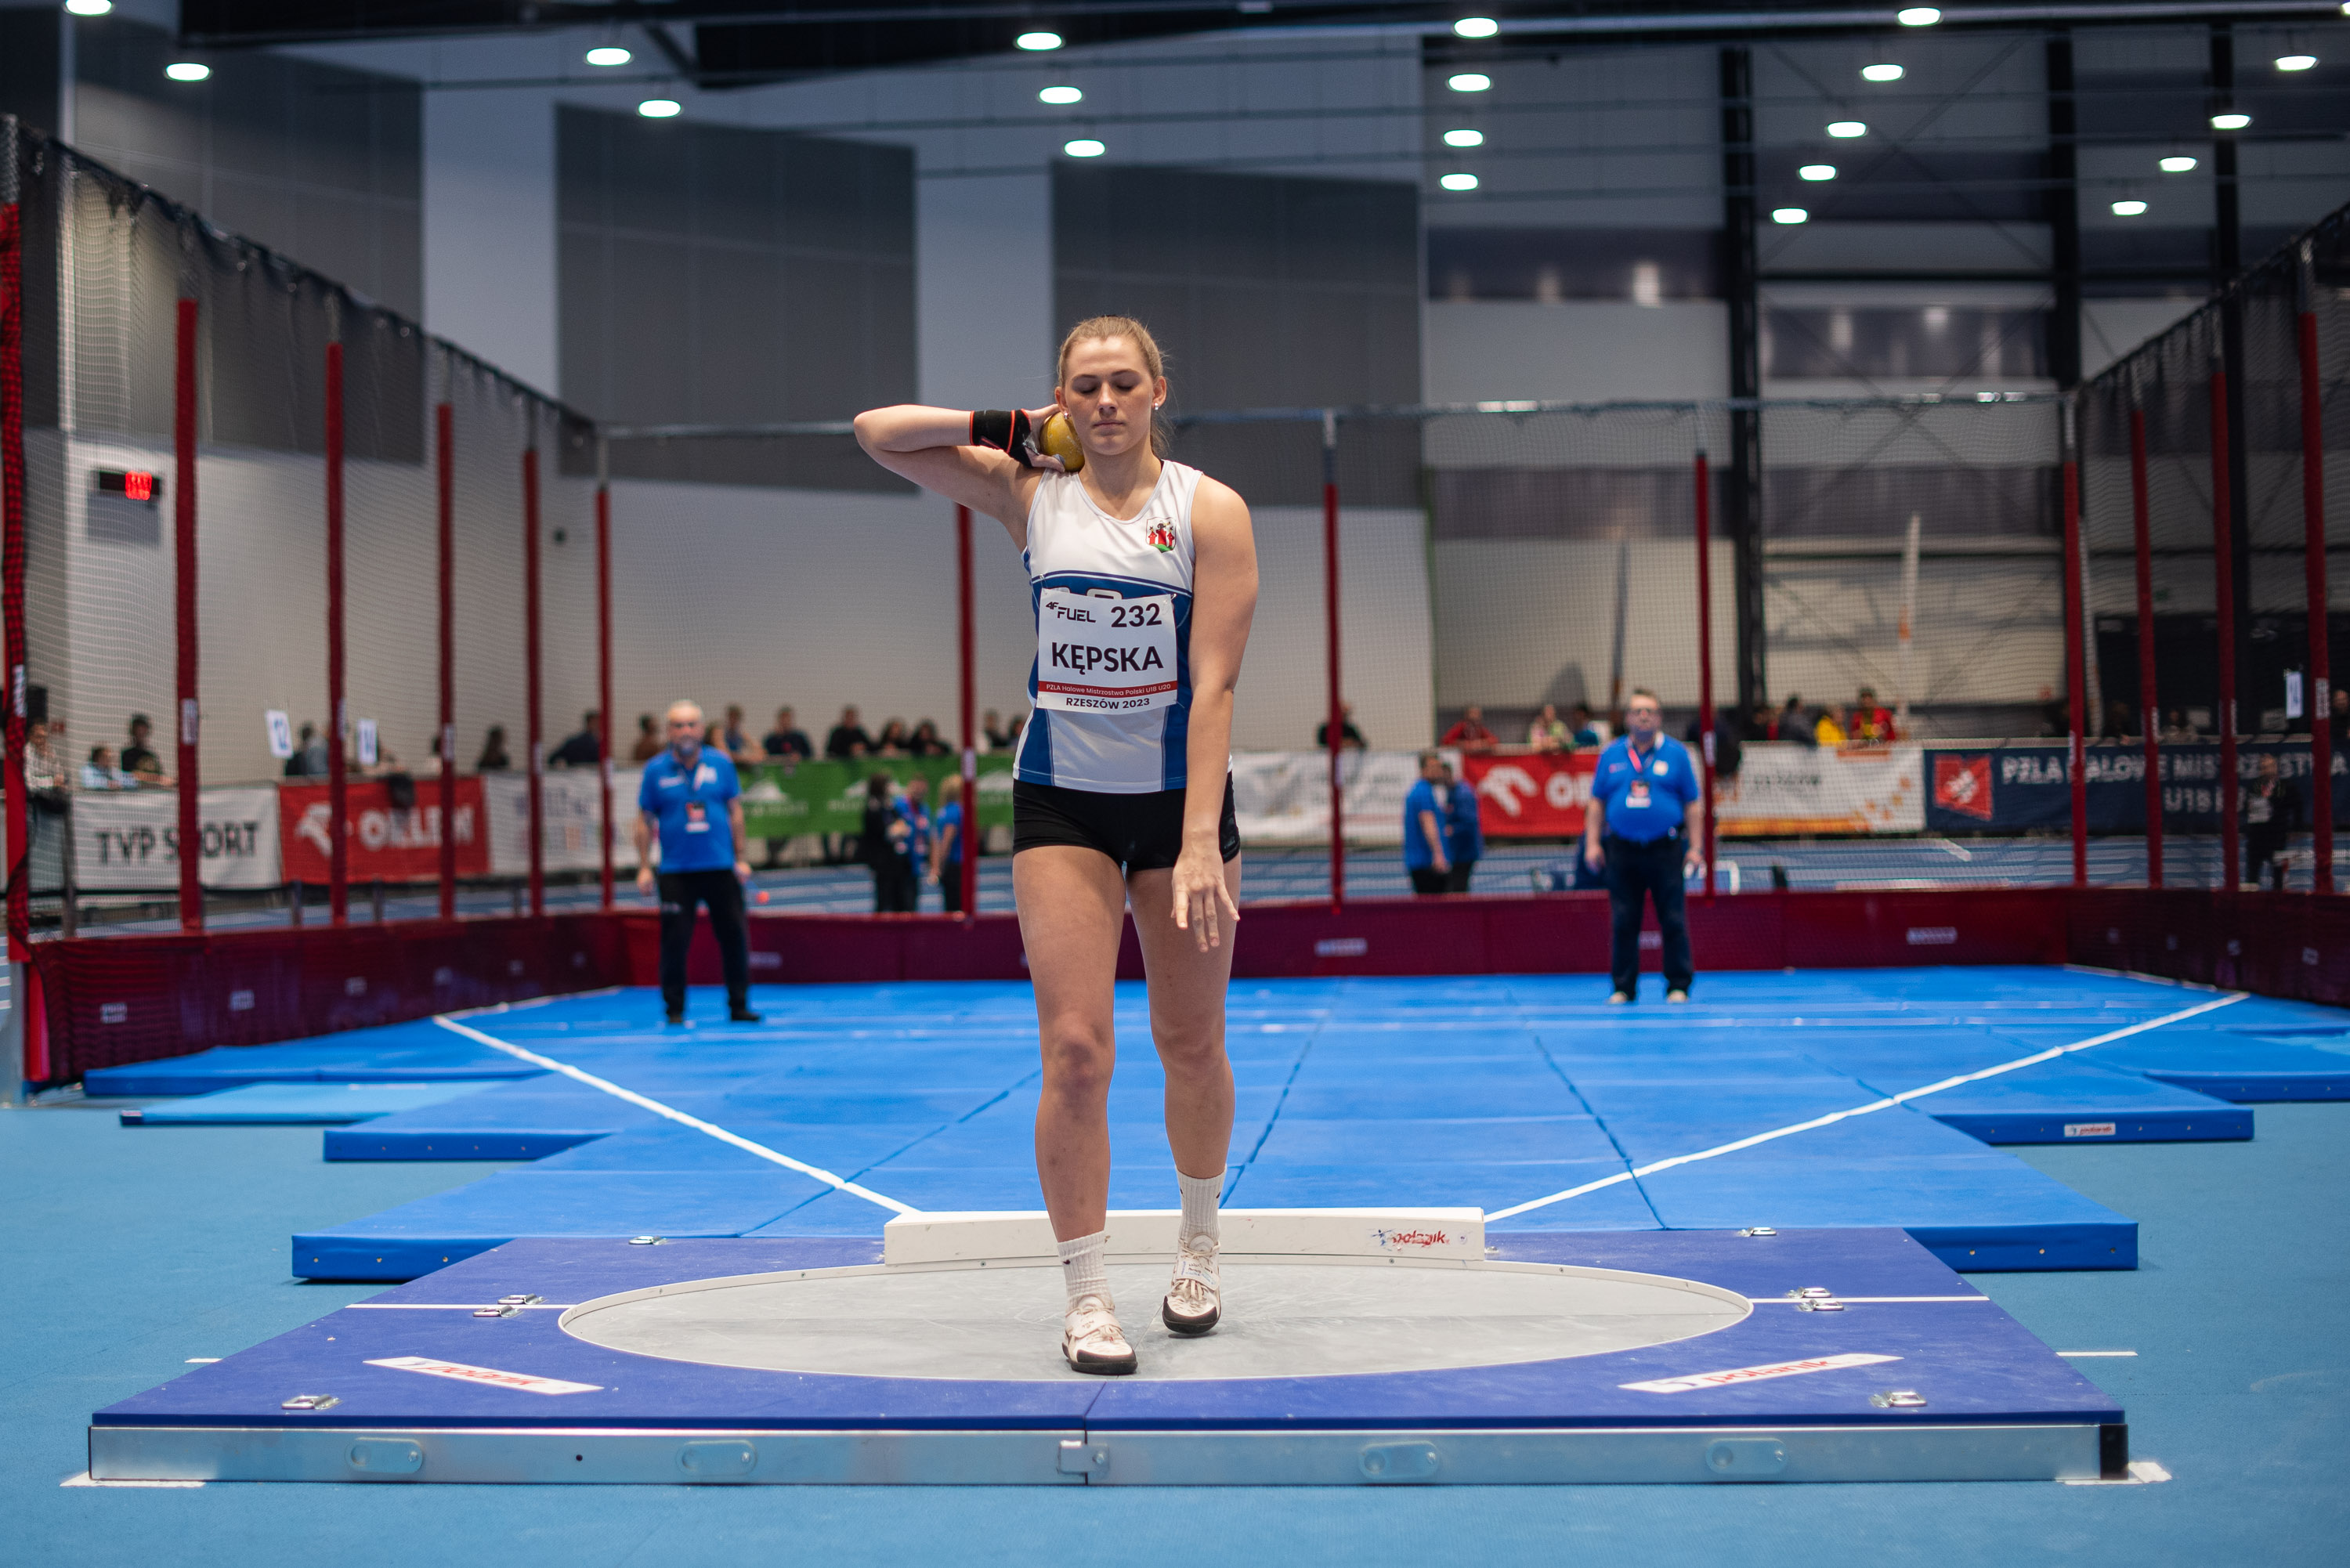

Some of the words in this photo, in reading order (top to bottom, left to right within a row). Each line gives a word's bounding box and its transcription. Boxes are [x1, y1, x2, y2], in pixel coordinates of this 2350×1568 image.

[1058, 607, 1096, 623] FUEL
[1110, 602, 1162, 628] 232
[1052, 641, 1164, 675] KĘPSKA
[1061, 685, 1086, 694] Halowe
[1086, 688, 1124, 696] Mistrzostwa
[1066, 696, 1119, 710] RZESZÓW
[1122, 697, 1151, 710] 2023
[95, 827, 155, 865] TVP
[163, 822, 258, 862] SORT
